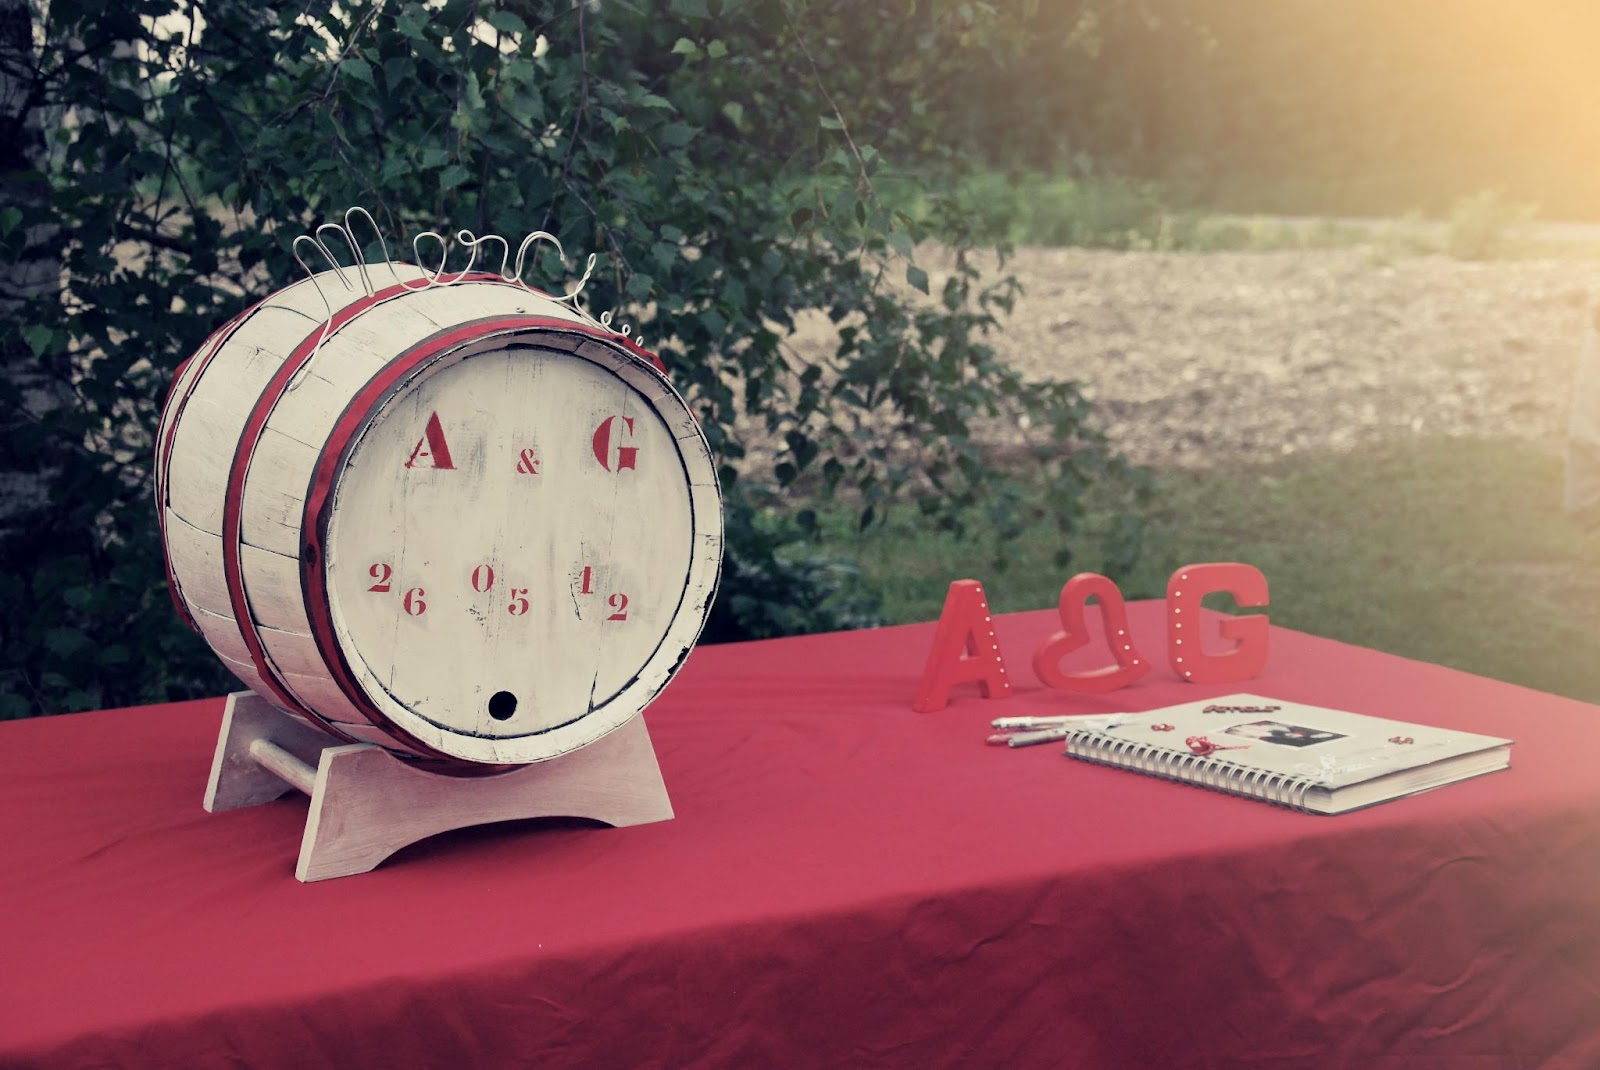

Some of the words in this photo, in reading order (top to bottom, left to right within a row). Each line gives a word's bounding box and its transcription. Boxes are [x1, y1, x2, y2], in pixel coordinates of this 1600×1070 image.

[404, 410, 457, 470] A
[516, 448, 540, 475] &
[592, 415, 640, 473] G
[911, 578, 1013, 713] A
[1166, 562, 1270, 684] G
